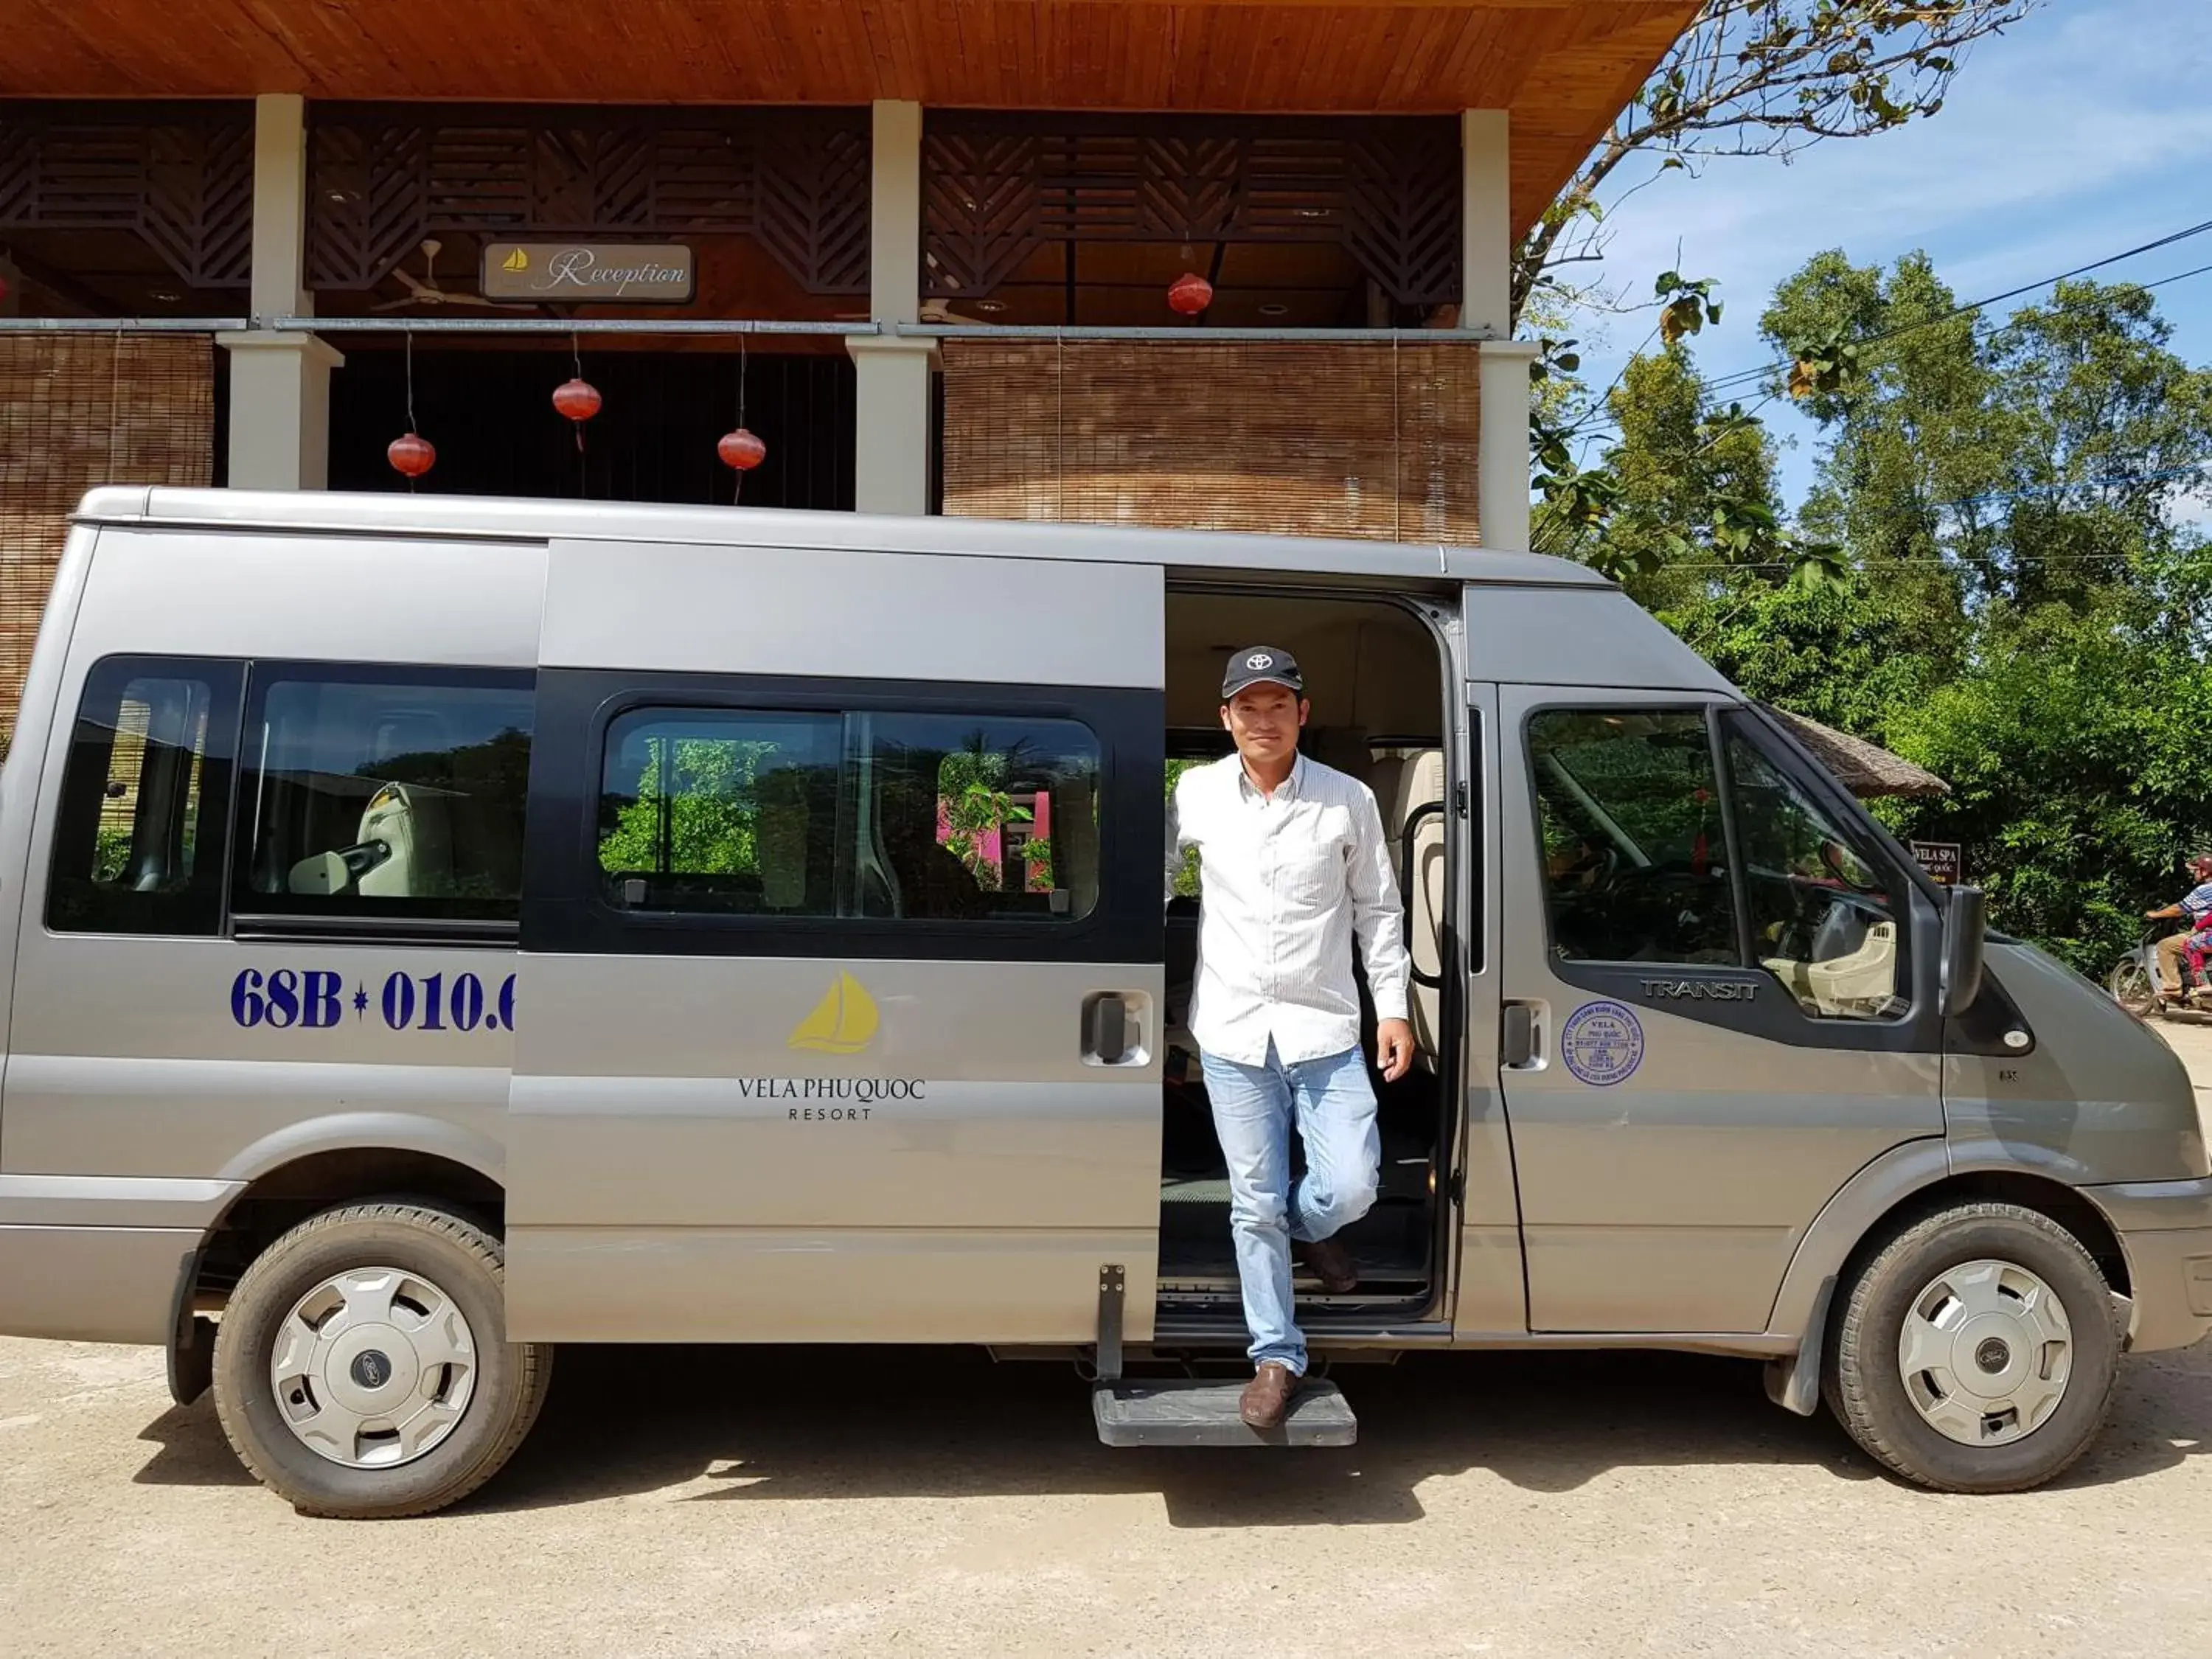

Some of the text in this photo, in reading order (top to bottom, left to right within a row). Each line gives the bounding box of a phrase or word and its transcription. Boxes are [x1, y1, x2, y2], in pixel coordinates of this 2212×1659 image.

[530, 248, 686, 296] Reception
[1939, 849, 1957, 862] SPA
[230, 968, 343, 1028] 68B
[1639, 979, 1759, 1001] TRANSIT
[789, 1108, 872, 1121] RESORT
